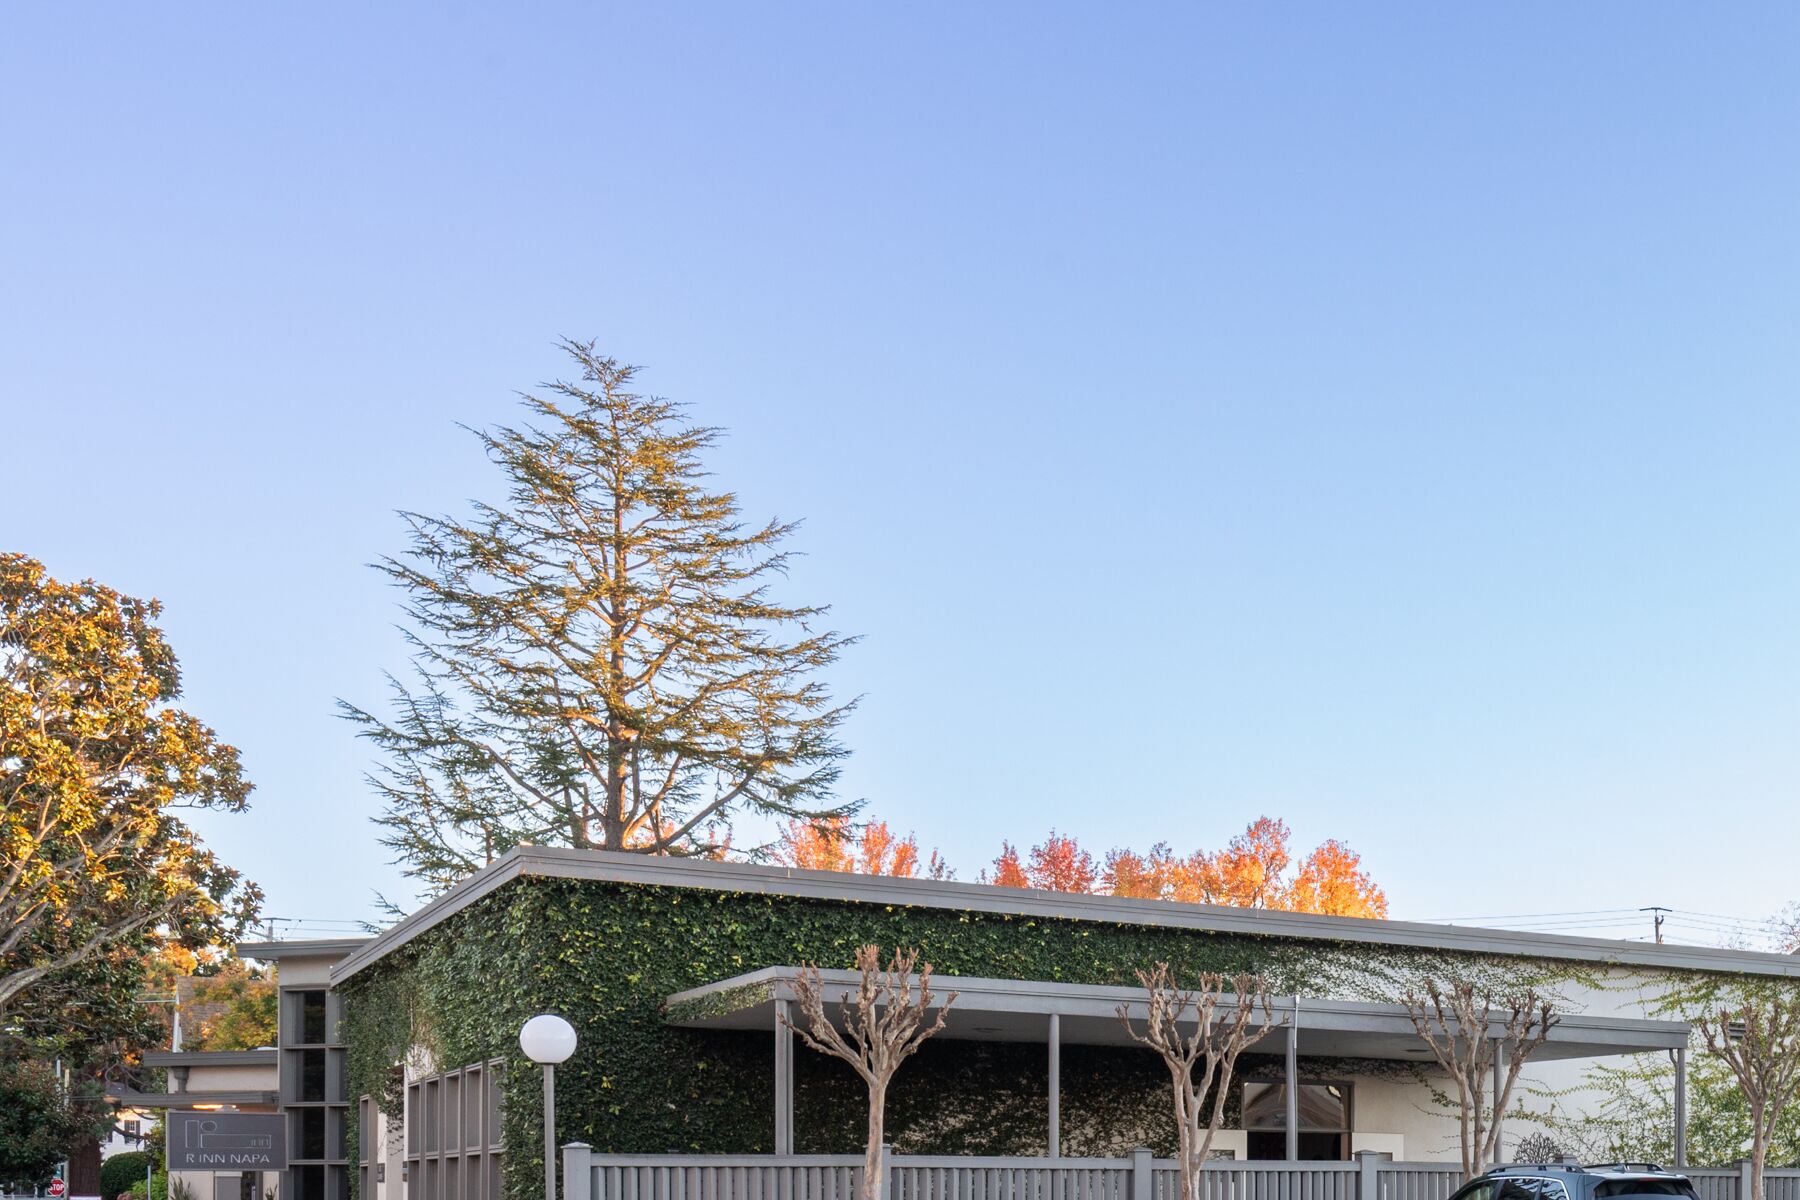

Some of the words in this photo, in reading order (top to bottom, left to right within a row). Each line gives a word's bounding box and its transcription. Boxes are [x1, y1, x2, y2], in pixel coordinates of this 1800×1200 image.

[186, 1154, 195, 1163] R
[199, 1154, 226, 1163] INN
[230, 1154, 270, 1163] NAPA
